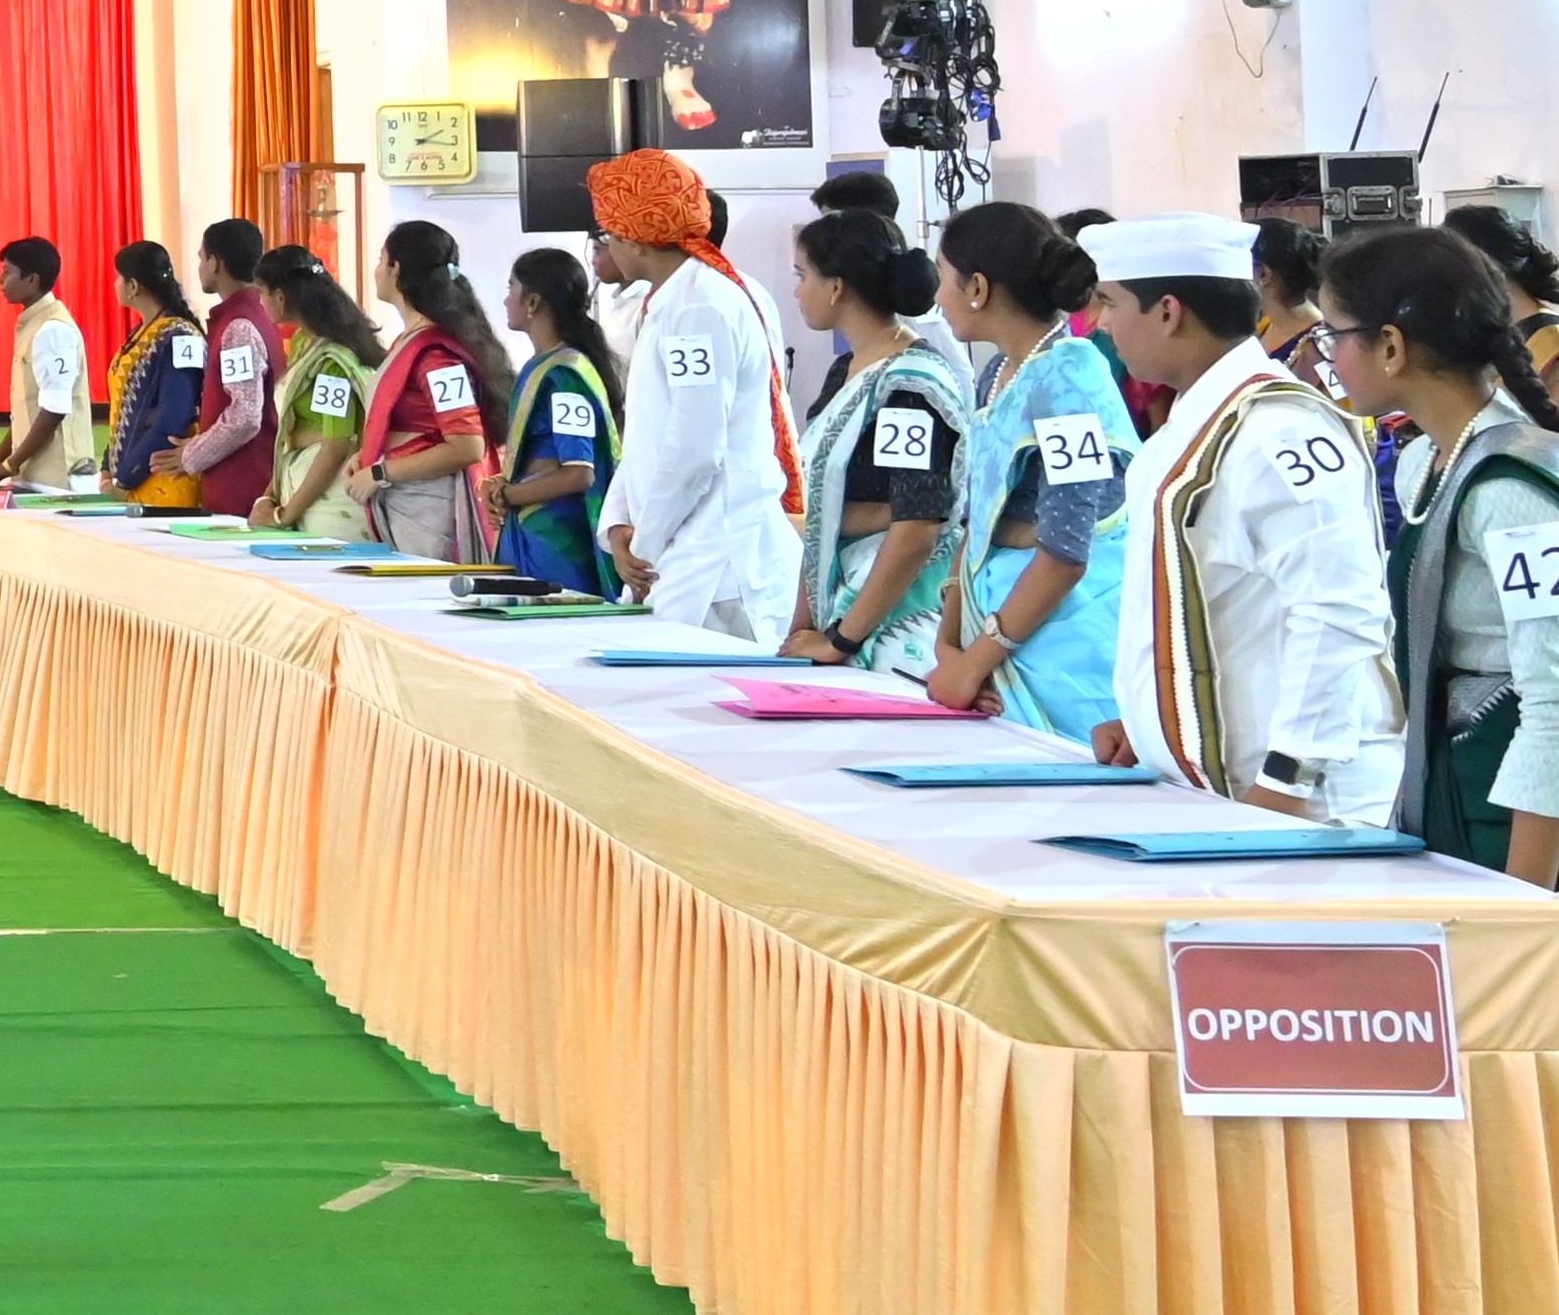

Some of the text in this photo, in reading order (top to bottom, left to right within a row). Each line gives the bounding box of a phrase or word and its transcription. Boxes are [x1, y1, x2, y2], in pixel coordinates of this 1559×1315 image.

[402, 112, 411, 122] 11
[418, 111, 428, 122] 12
[437, 111, 440, 121] 1
[451, 117, 458, 127] 2
[387, 120, 398, 130] 10
[388, 136, 395, 146] 9
[451, 135, 458, 145] 3
[389, 153, 396, 163] 8
[451, 152, 458, 161] 4
[406, 160, 412, 172] 7
[421, 160, 428, 170] 6
[438, 159, 445, 170] 5
[180, 344, 193, 361] 4
[54, 357, 69, 375] 2
[224, 355, 250, 378] 31
[670, 347, 711, 377] 33
[317, 383, 345, 409] 38
[434, 377, 468, 403] 27
[557, 401, 590, 427] 29
[881, 424, 927, 457] 28
[1044, 431, 1104, 470] 34
[1276, 435, 1345, 487] 30
[1187, 1008, 1436, 1044] OPPOSITION
